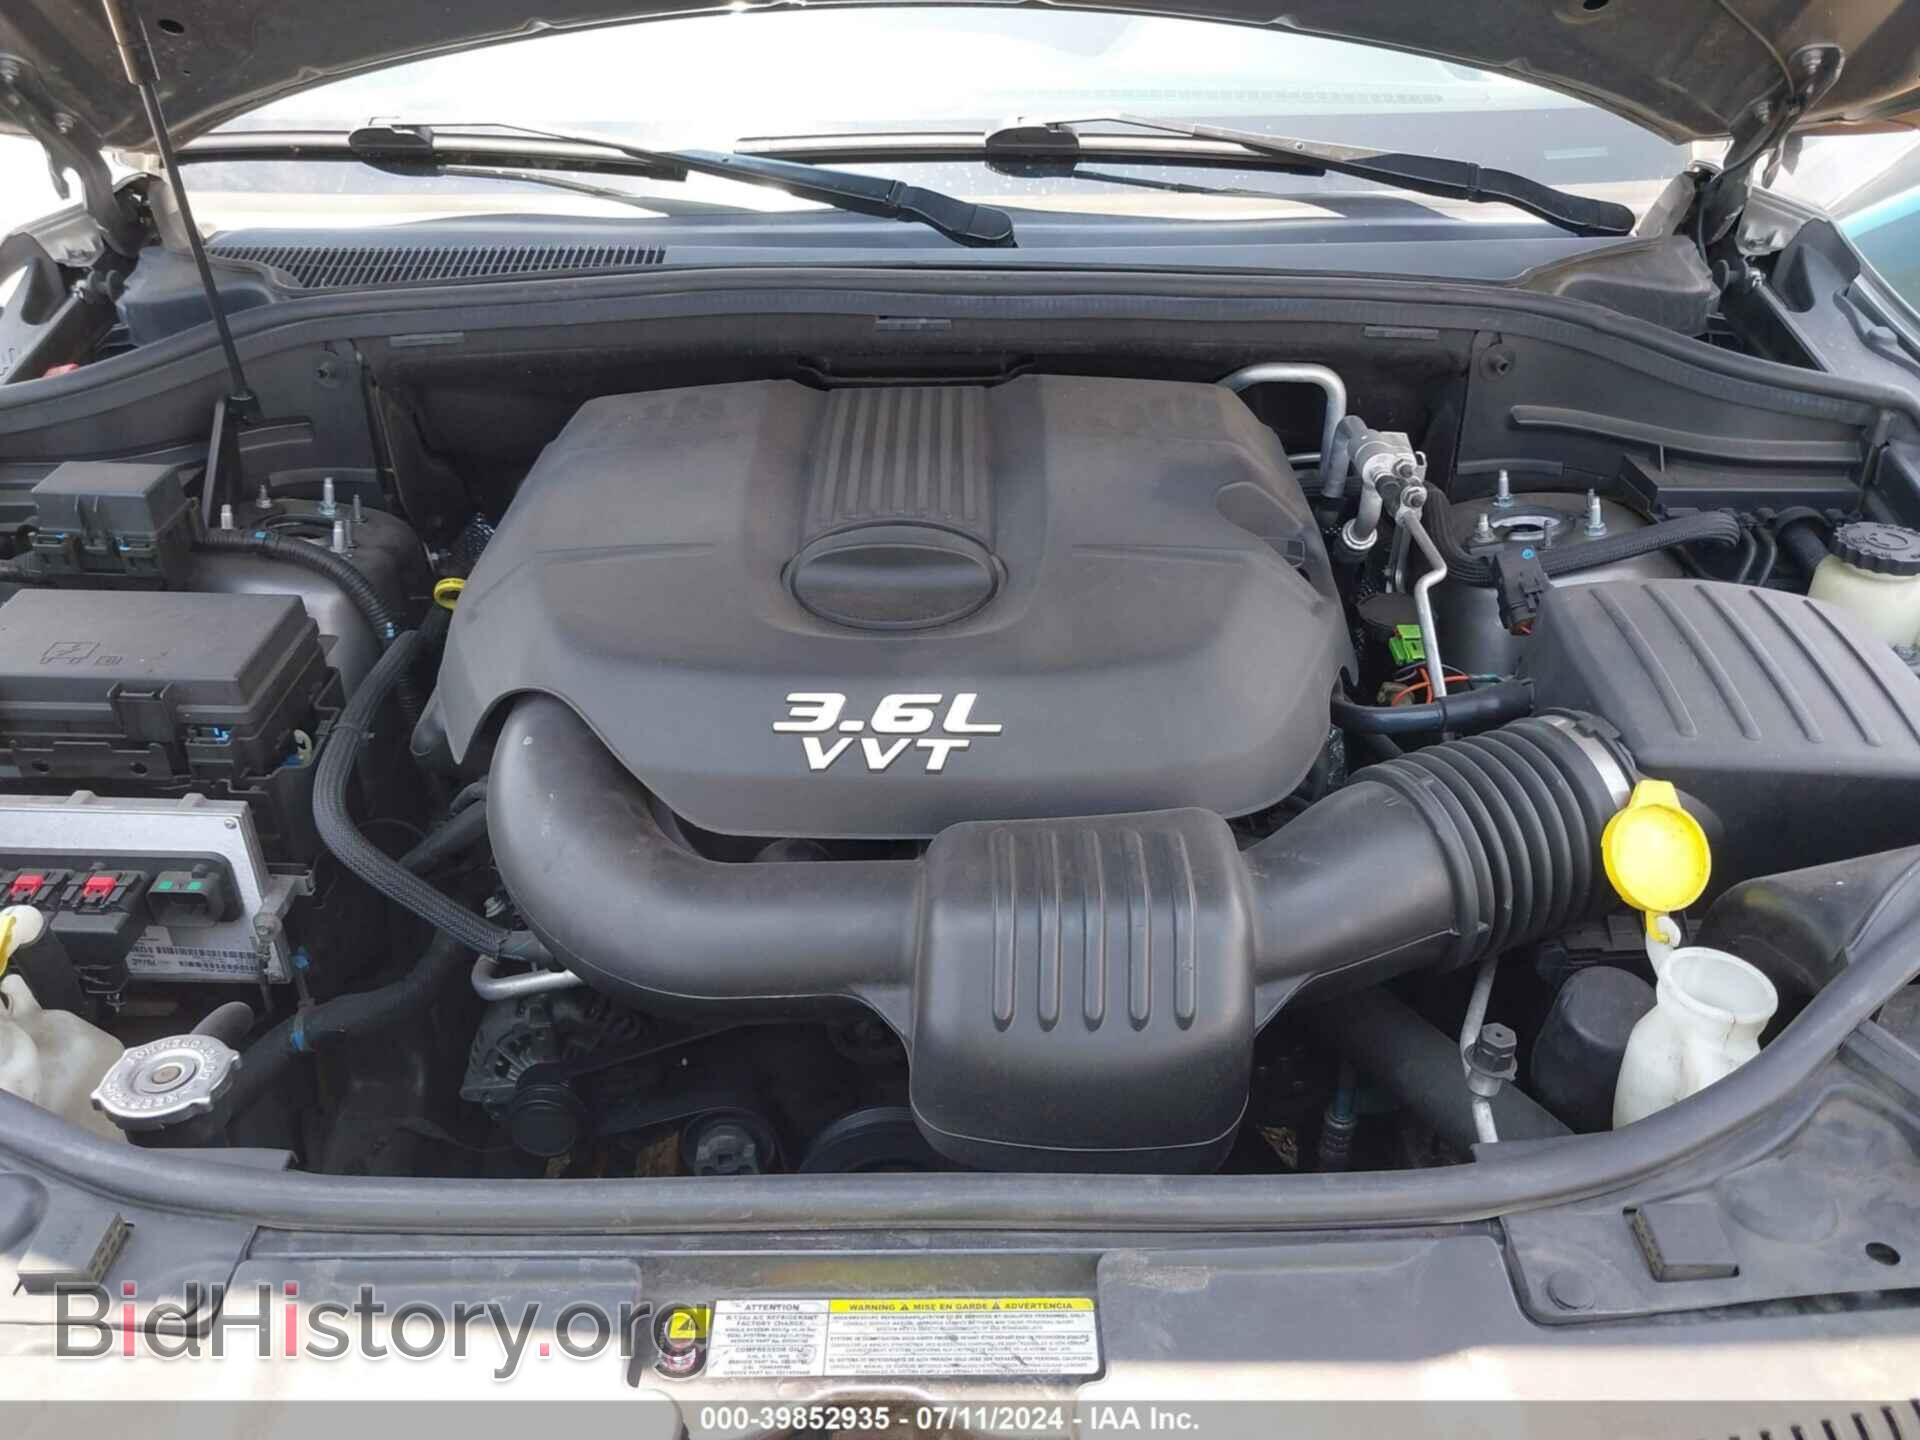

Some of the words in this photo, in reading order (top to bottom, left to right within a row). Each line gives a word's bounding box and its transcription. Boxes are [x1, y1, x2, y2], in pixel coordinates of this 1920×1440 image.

[772, 692, 1002, 733] 3.6L
[802, 737, 971, 772] VVT
[744, 1303, 800, 1311] ATTENTION
